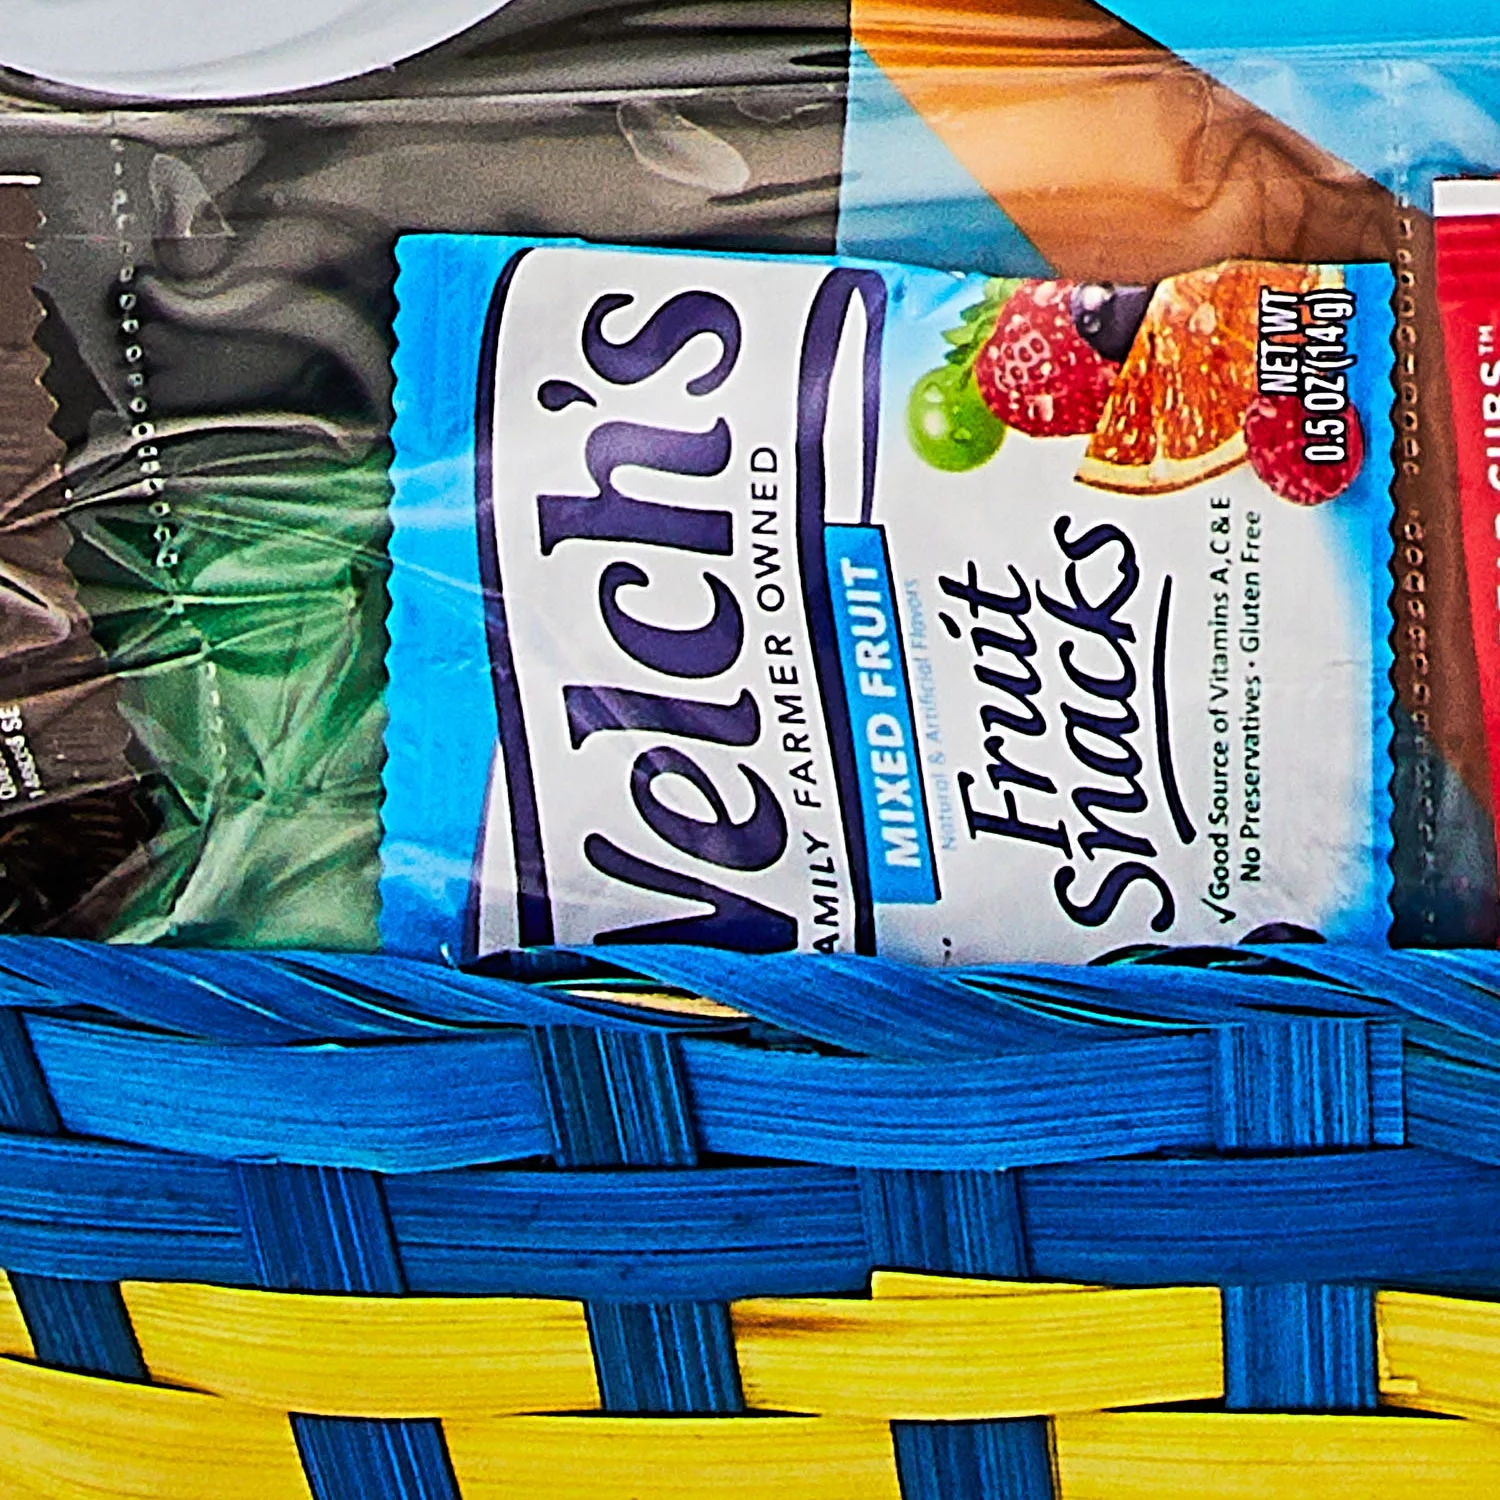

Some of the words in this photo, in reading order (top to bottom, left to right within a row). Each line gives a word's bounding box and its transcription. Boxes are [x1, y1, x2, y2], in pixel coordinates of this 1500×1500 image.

[1260, 288, 1298, 334] WT
[1260, 339, 1298, 393] NET
[1304, 419, 1346, 462] 0.5
[750, 445, 785, 613] OWNED
[1210, 496, 1231, 509] E
[1210, 516, 1231, 535] &
[1240, 511, 1262, 564] Free
[841, 558, 895, 697] FRUIT
[904, 577, 928, 650] Flavors
[1208, 592, 1229, 701] Vitamins
[1239, 571, 1261, 654] Gluten
[767, 635, 822, 808] FARMER
[912, 657, 943, 744] Artificial
[938, 561, 1074, 859] Fruit
[1036, 515, 1177, 933] Snacks
[1208, 708, 1229, 734] of
[865, 715, 922, 869] MIXED
[1208, 740, 1229, 826] Source
[1239, 675, 1262, 839] Preservatives
[931, 773, 957, 852] Natural
[1240, 846, 1262, 882] No
